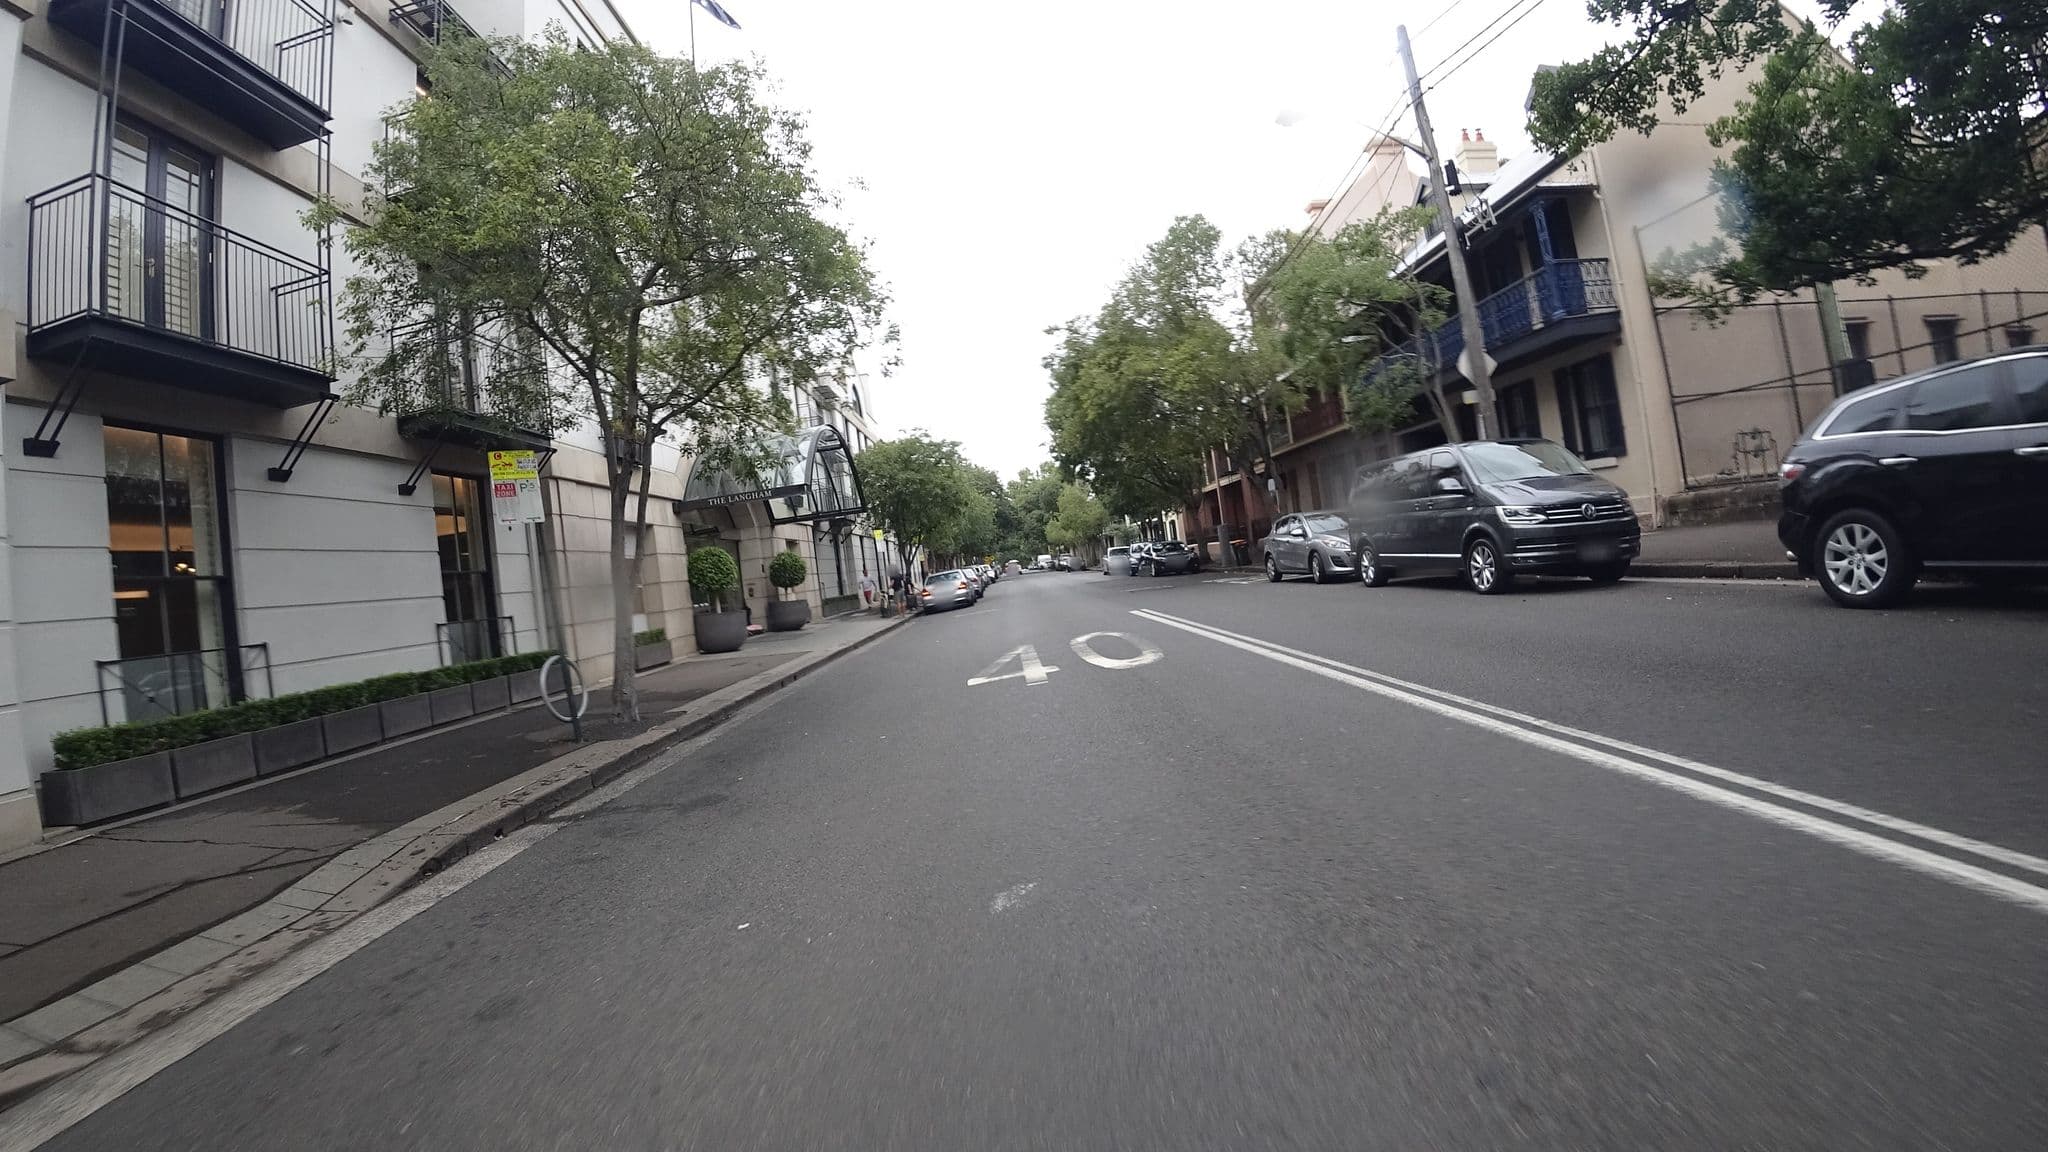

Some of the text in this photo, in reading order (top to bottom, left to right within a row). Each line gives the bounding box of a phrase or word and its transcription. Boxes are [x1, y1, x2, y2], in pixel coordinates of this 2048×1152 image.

[708, 490, 772, 506] THE LANGHAM
[967, 631, 1164, 687] 40
